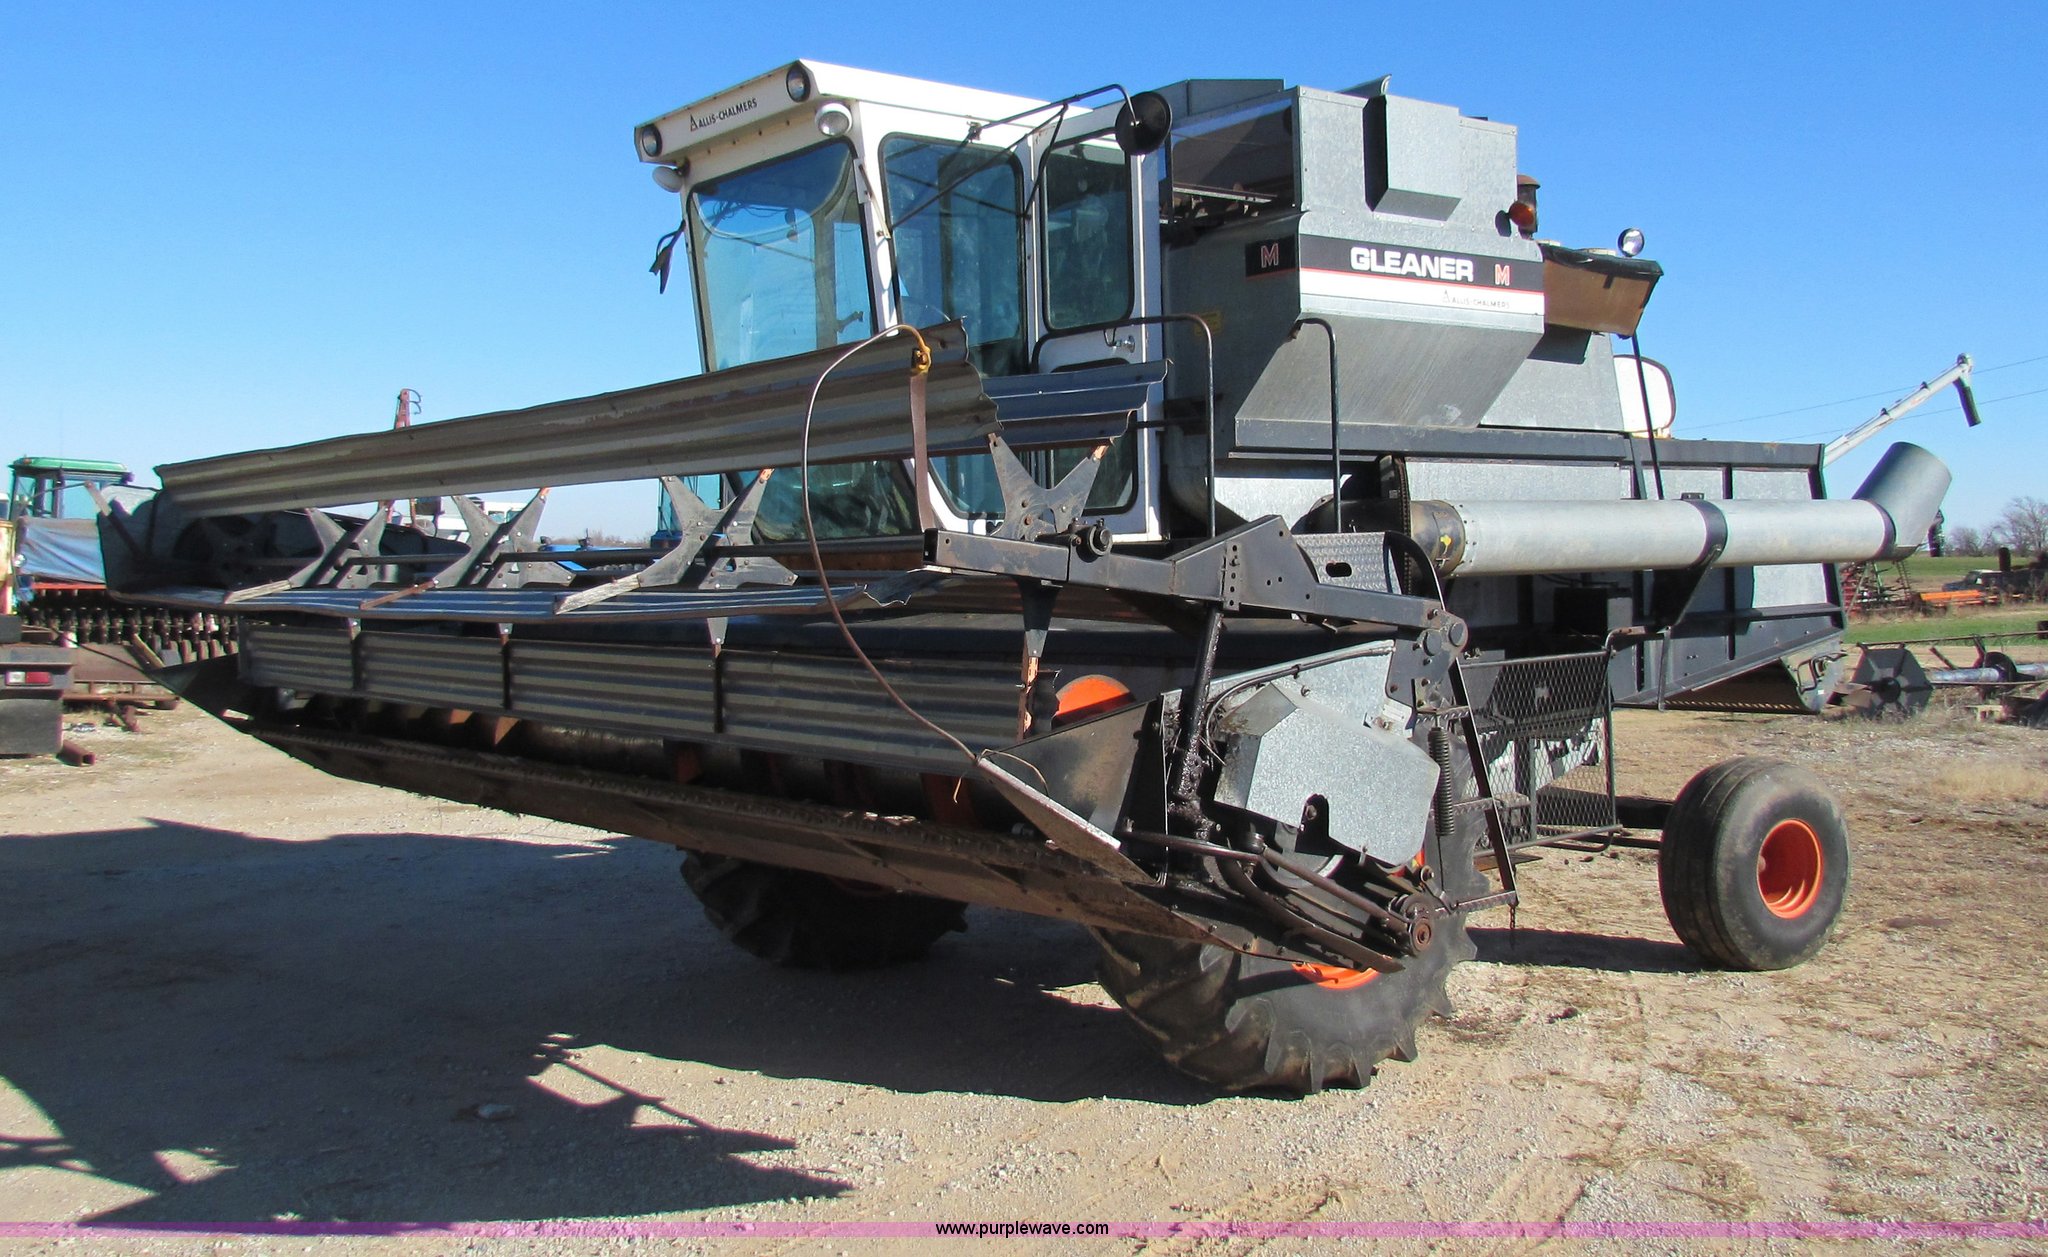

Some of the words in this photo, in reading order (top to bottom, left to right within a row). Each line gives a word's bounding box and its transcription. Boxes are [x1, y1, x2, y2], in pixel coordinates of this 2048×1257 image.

[698, 98, 758, 129] ALLIS-CHALMERS
[1261, 243, 1279, 268] M
[1350, 247, 1474, 282] GLEANER
[1495, 264, 1510, 286] M
